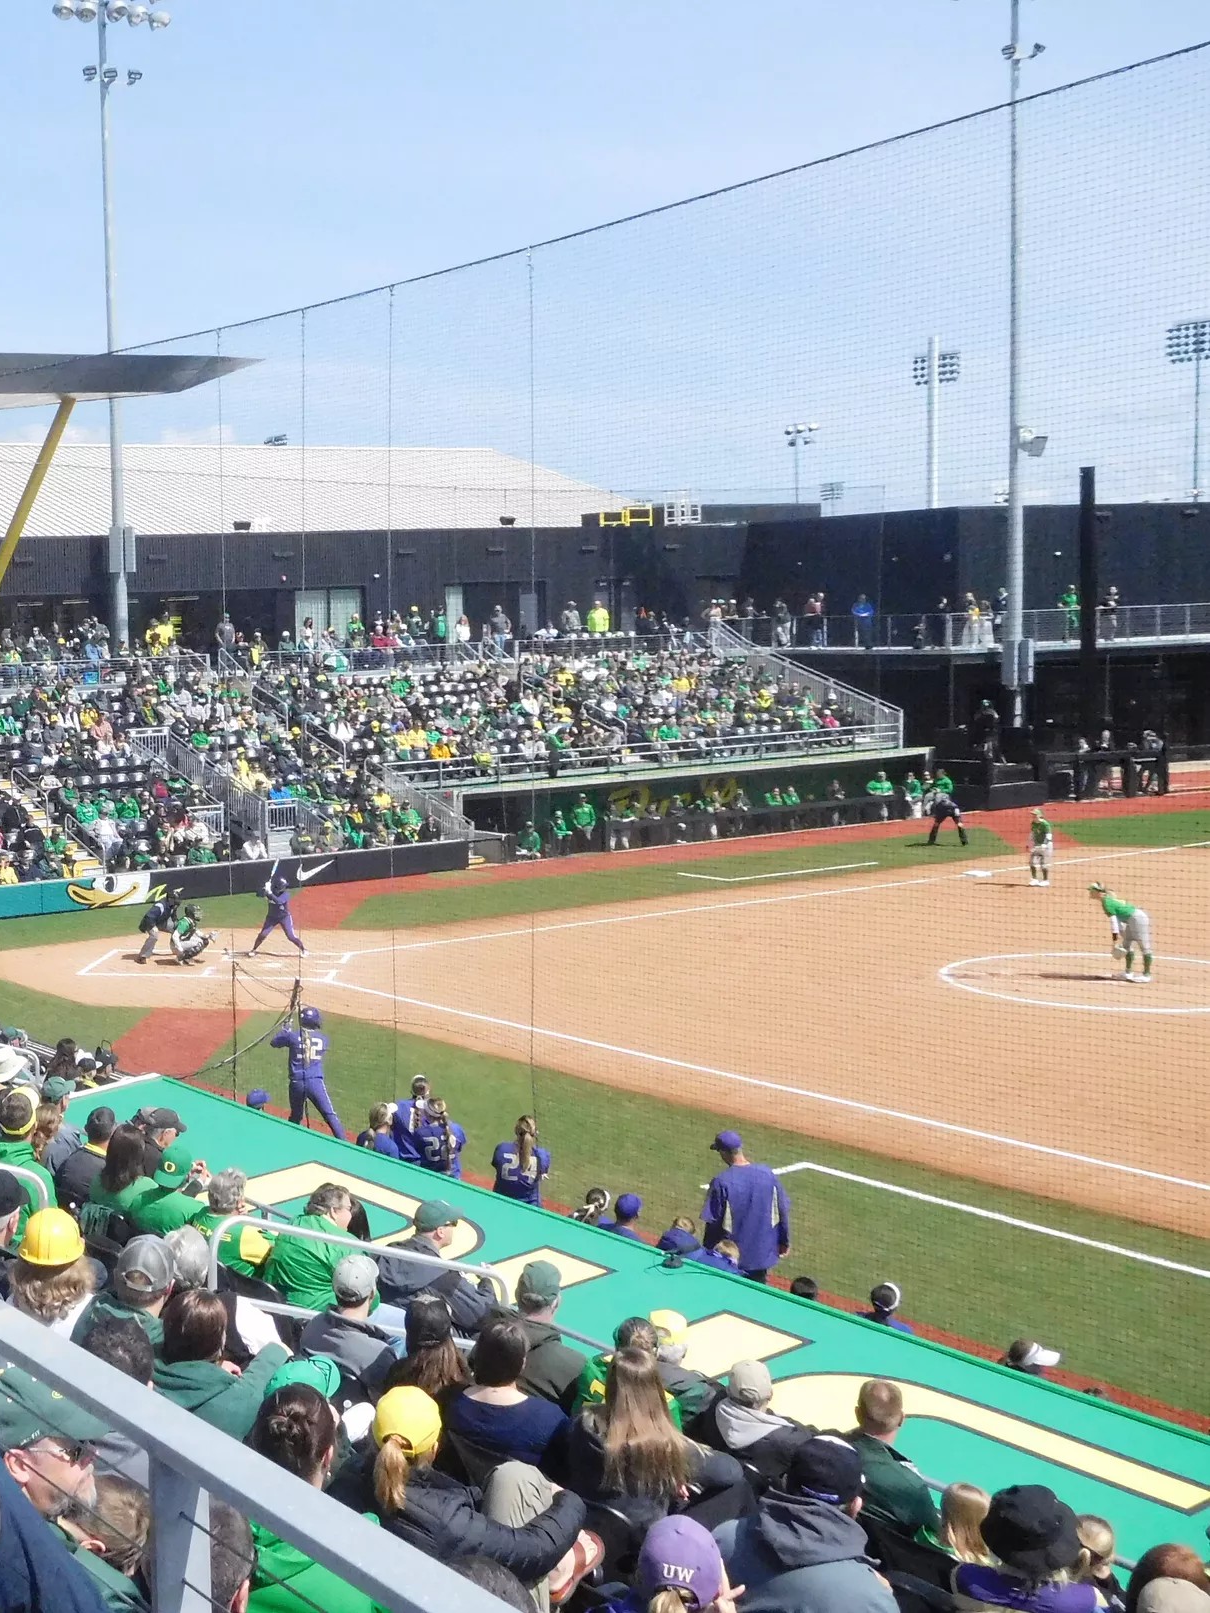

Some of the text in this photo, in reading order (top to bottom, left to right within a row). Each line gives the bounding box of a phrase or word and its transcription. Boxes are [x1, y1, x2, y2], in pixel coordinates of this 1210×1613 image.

[164, 1161, 176, 1173] O
[501, 1152, 538, 1184] 24
[662, 1563, 695, 1583] UW
